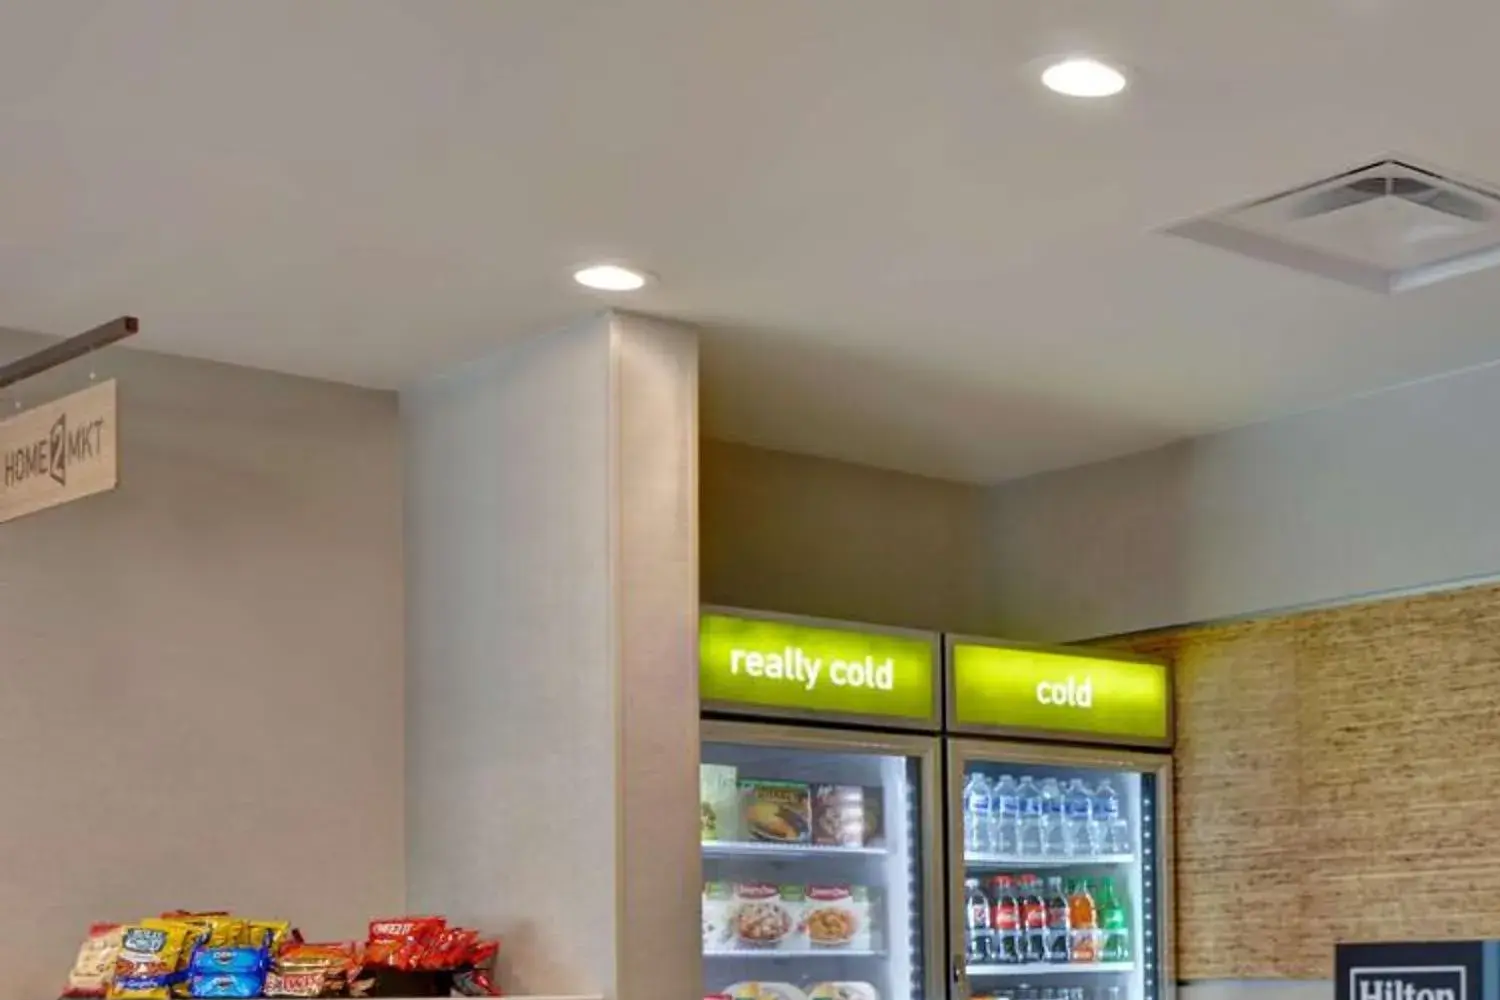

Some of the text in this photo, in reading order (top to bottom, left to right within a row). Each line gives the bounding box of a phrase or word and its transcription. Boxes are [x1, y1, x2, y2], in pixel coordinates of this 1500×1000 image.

[68, 418, 104, 465] MKT
[729, 646, 894, 691] really cold
[1036, 675, 1093, 708] cold
